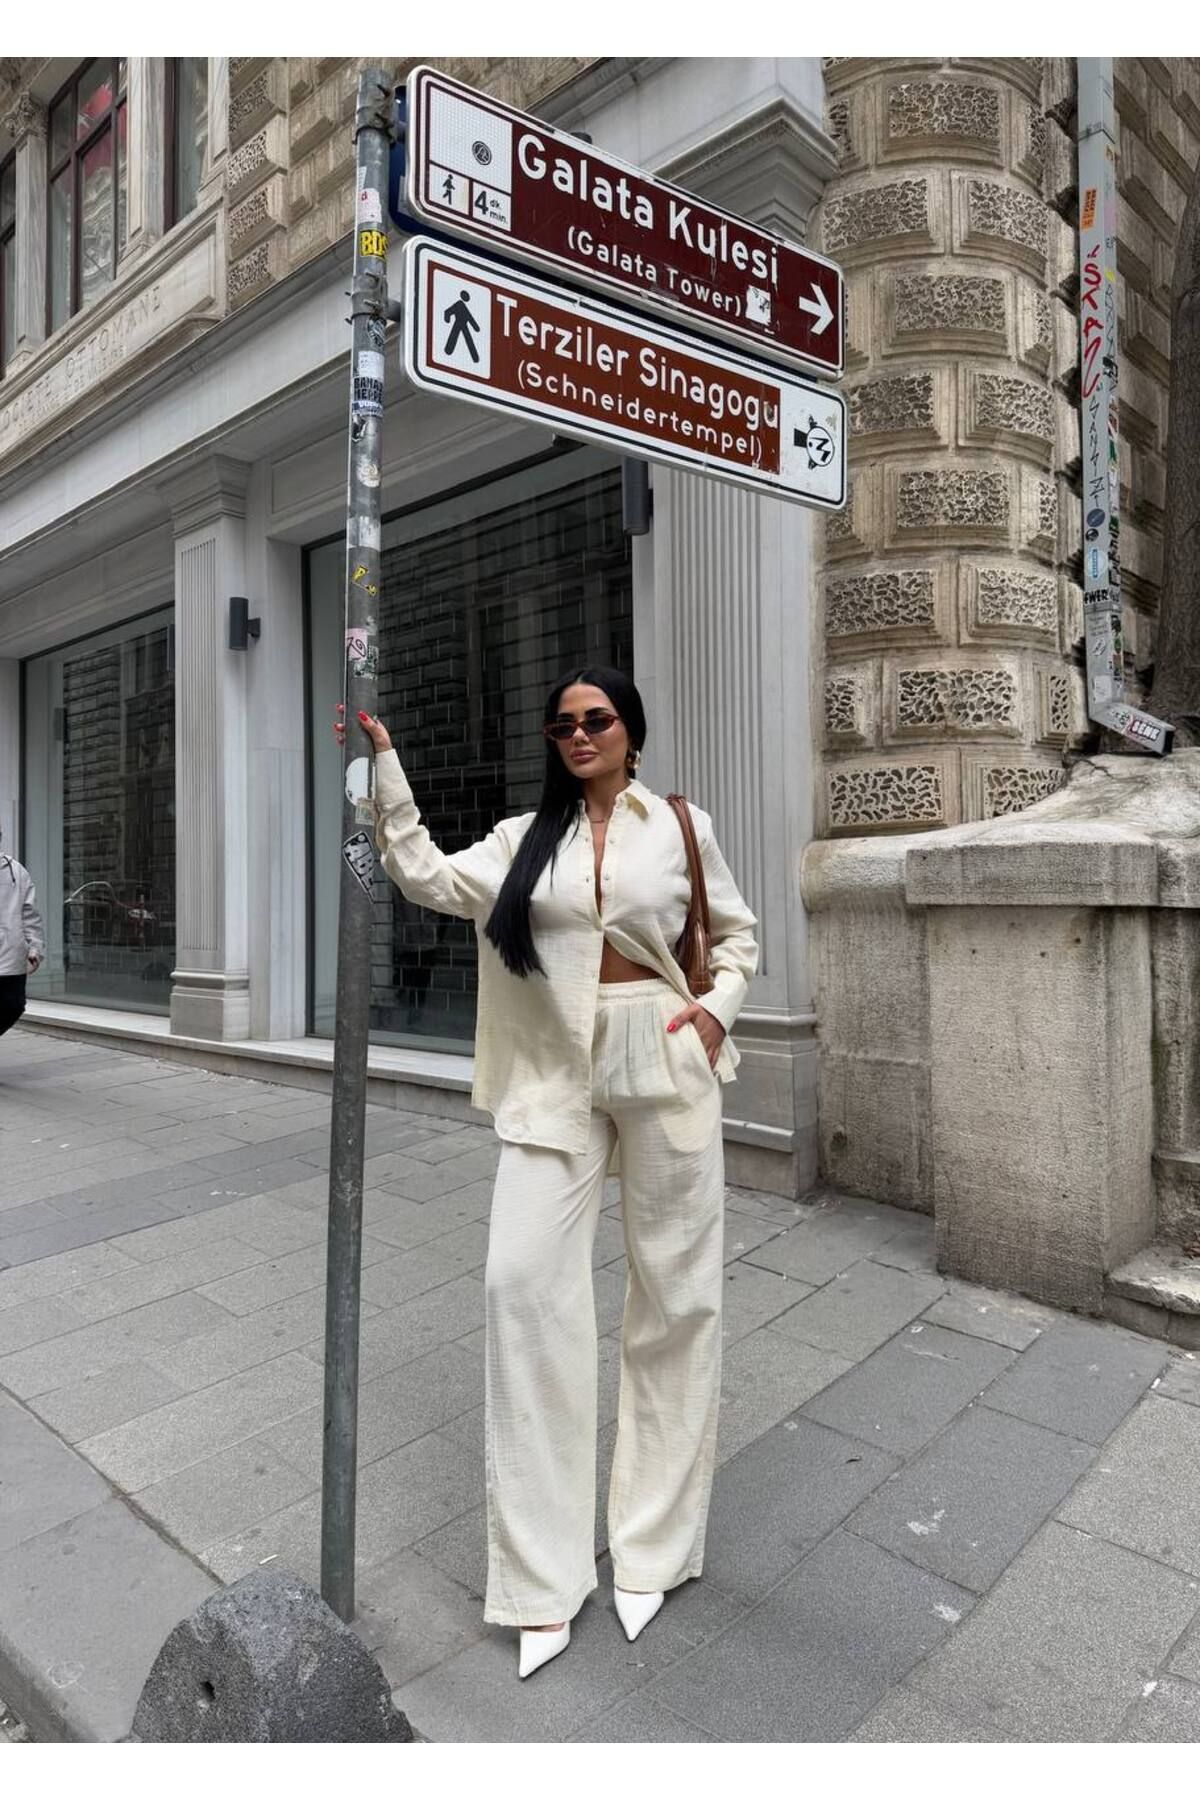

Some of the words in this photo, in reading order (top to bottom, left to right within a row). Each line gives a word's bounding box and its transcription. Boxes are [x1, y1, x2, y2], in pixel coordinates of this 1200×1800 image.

[475, 190, 489, 215] 4
[517, 133, 655, 230] Galata
[668, 199, 779, 285] Kulesi
[567, 225, 657, 282] (Galata
[666, 267, 743, 317] Tower)
[496, 293, 629, 376] Terziler
[639, 347, 780, 431] Sinagogu
[517, 359, 763, 461] (Schneidertempel)
